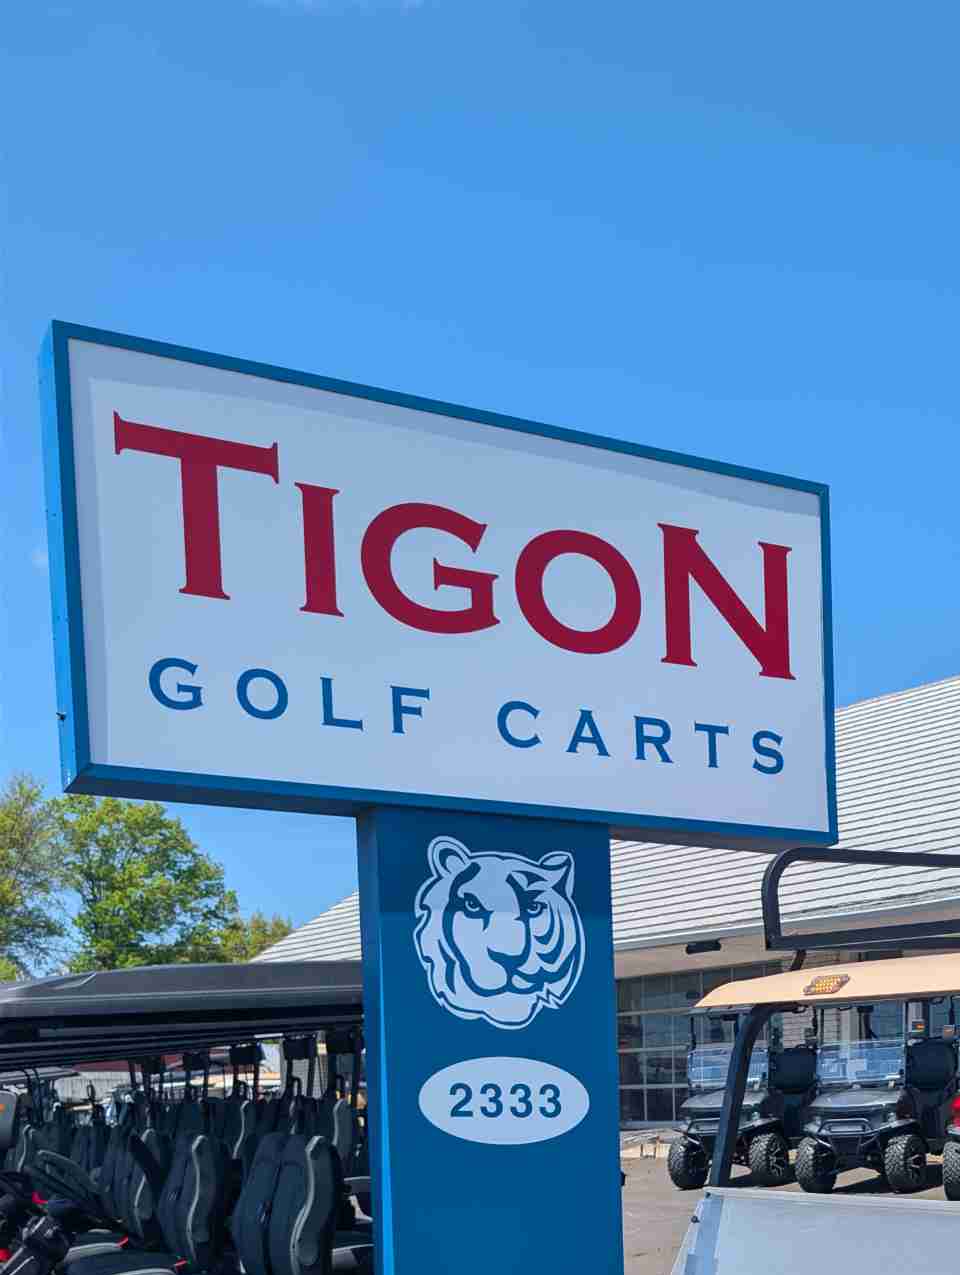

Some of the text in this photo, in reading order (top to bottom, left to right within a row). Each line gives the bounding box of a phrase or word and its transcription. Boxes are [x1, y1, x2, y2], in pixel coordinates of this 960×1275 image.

[114, 412, 796, 681] TIGON
[148, 657, 785, 775] GOLF CARTS
[449, 1082, 563, 1119] 2333
